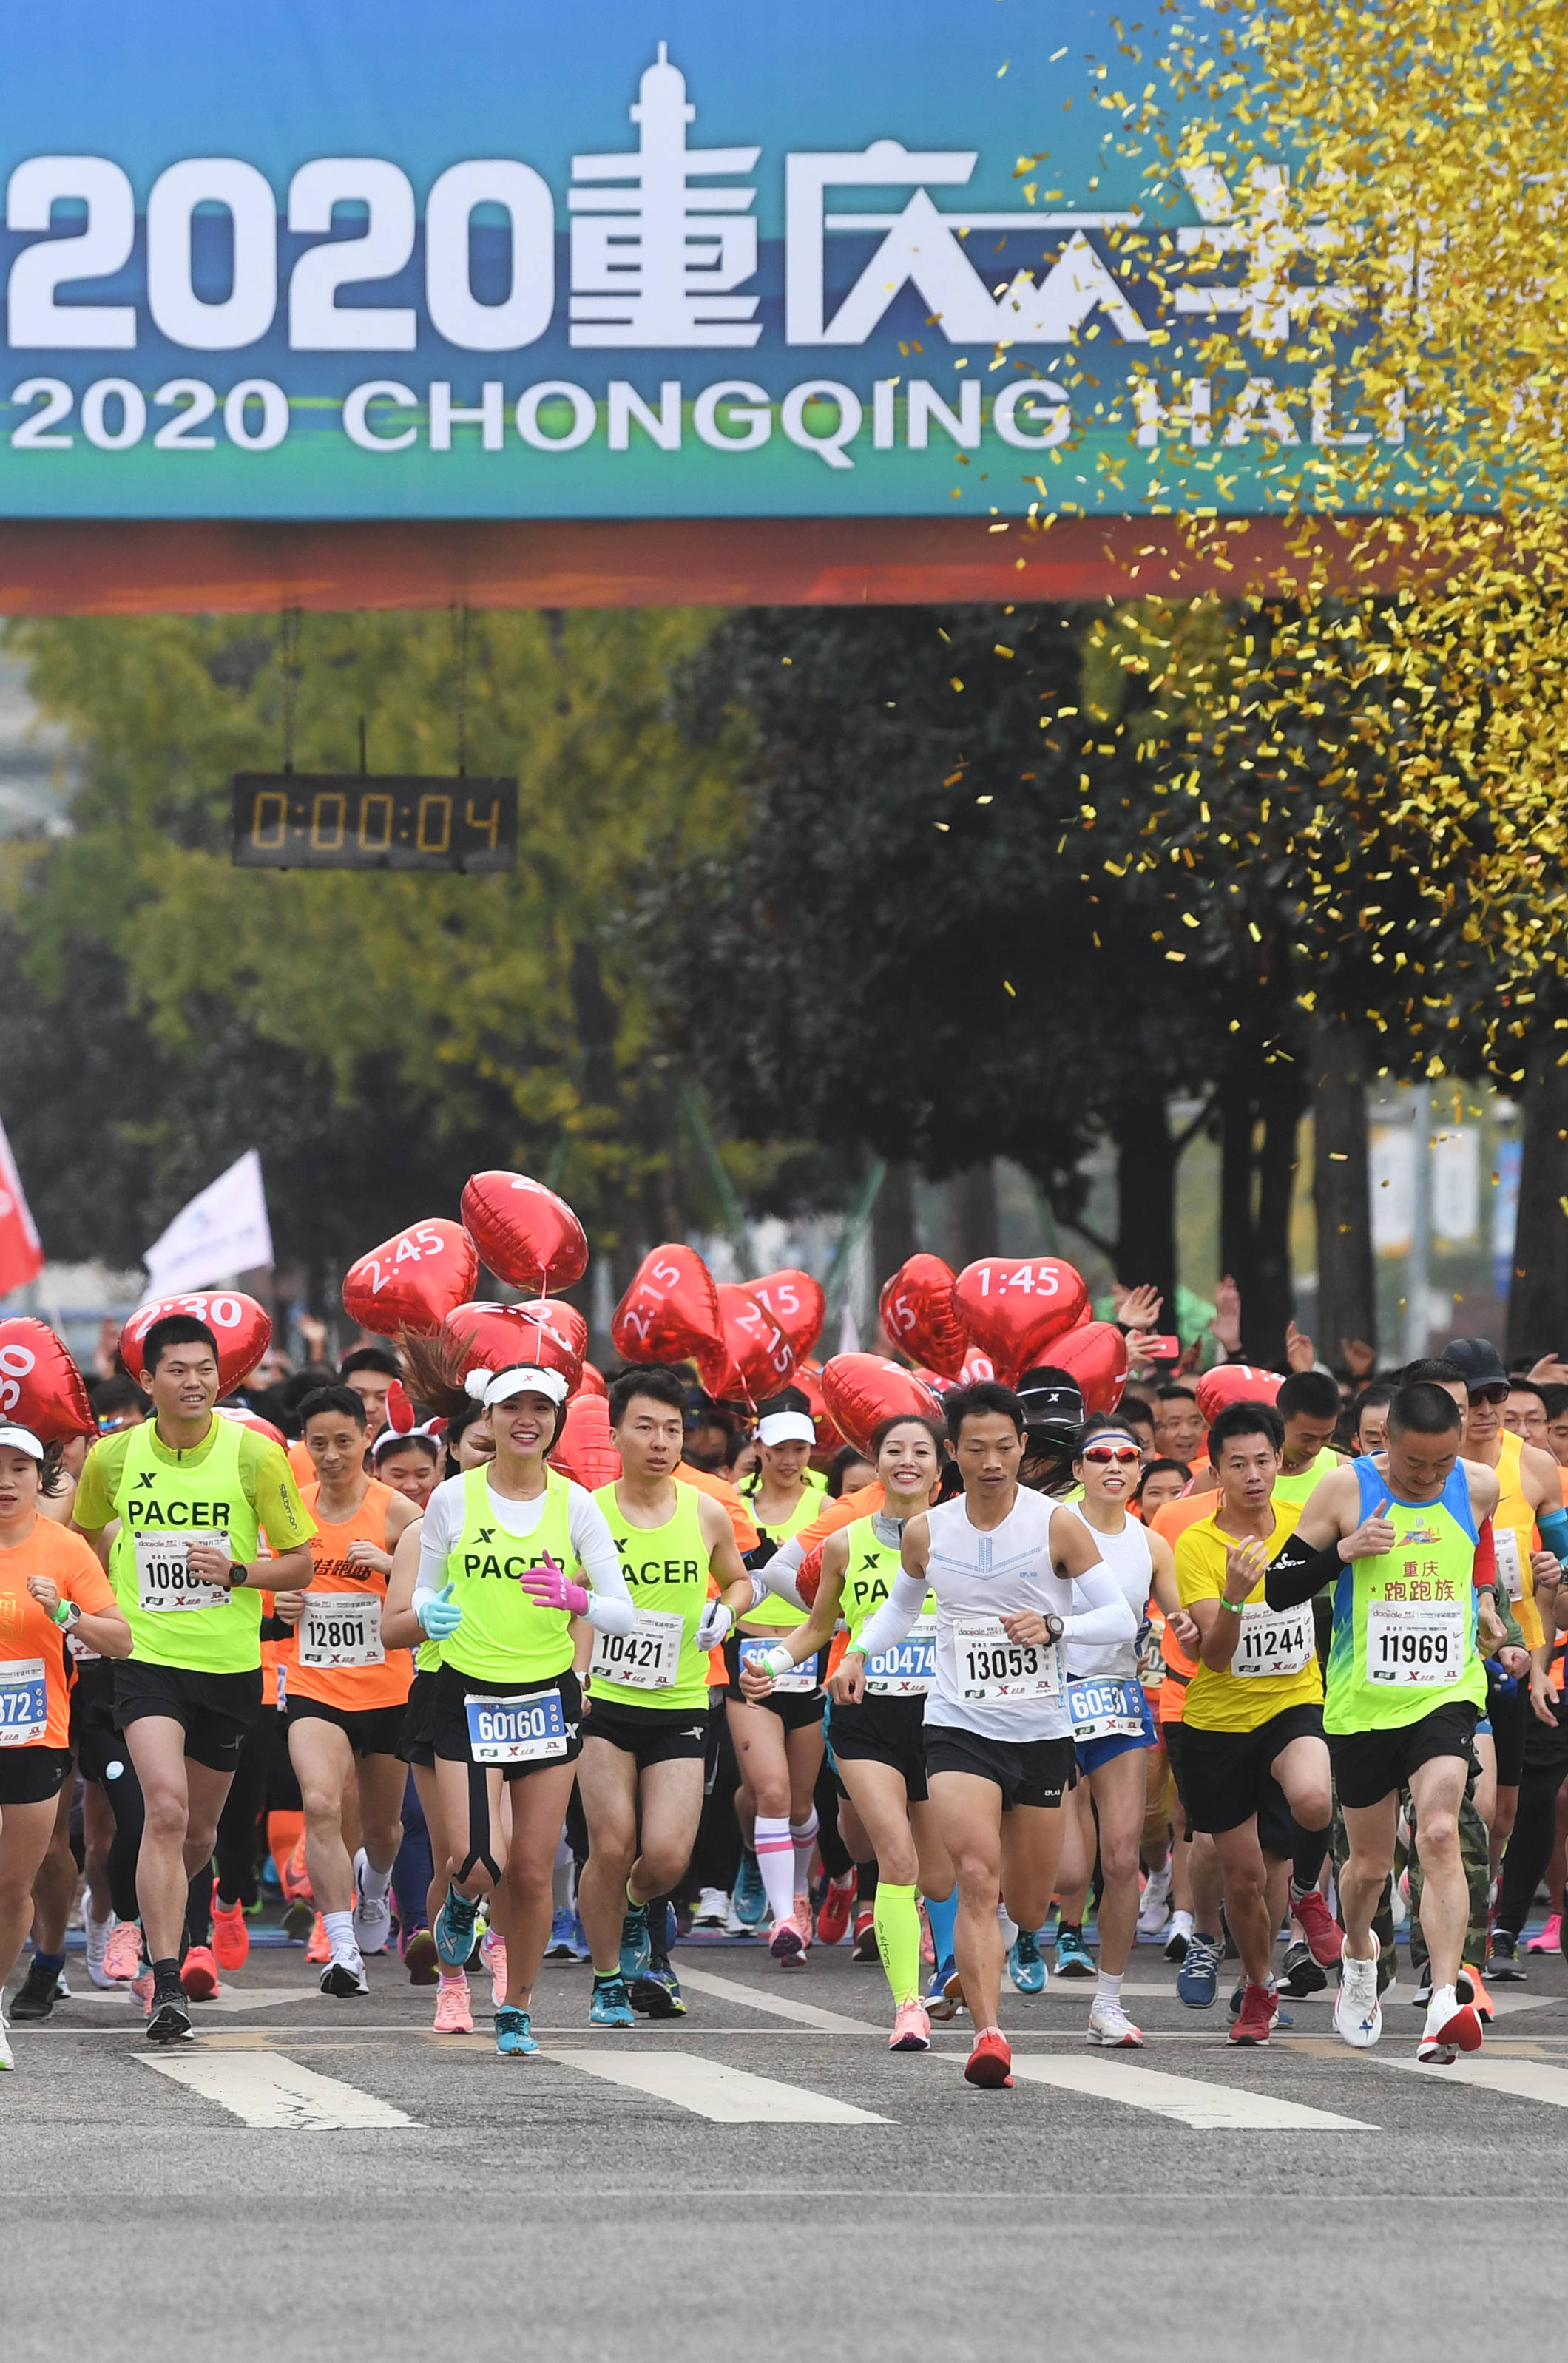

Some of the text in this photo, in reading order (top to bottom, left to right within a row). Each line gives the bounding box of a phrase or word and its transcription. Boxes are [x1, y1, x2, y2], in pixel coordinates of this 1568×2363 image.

[9, 378, 289, 450] 2020
[342, 379, 1071, 469] CHONGQING
[252, 791, 500, 852] 0:00:04
[361, 1228, 444, 1294] 2:45
[978, 1265, 1059, 1296] 1:45
[624, 1260, 680, 1339] 2:15
[735, 1302, 793, 1372] 2:15
[129, 1501, 231, 1527] PACER
[145, 1562, 213, 1589] 108
[623, 1560, 698, 1586] ACER
[1403, 1561, 1439, 1578] 重庆
[1384, 1579, 1456, 1602] 跑跑族
[308, 1621, 365, 1647] 12801
[1243, 1625, 1304, 1658] 11244
[1379, 1635, 1448, 1663] 11969
[601, 1634, 663, 1669] 10421
[871, 1646, 936, 1674] 60474
[966, 1647, 1038, 1680] 13053
[1071, 1686, 1128, 1719] 60531
[479, 1707, 546, 1741] 60160
